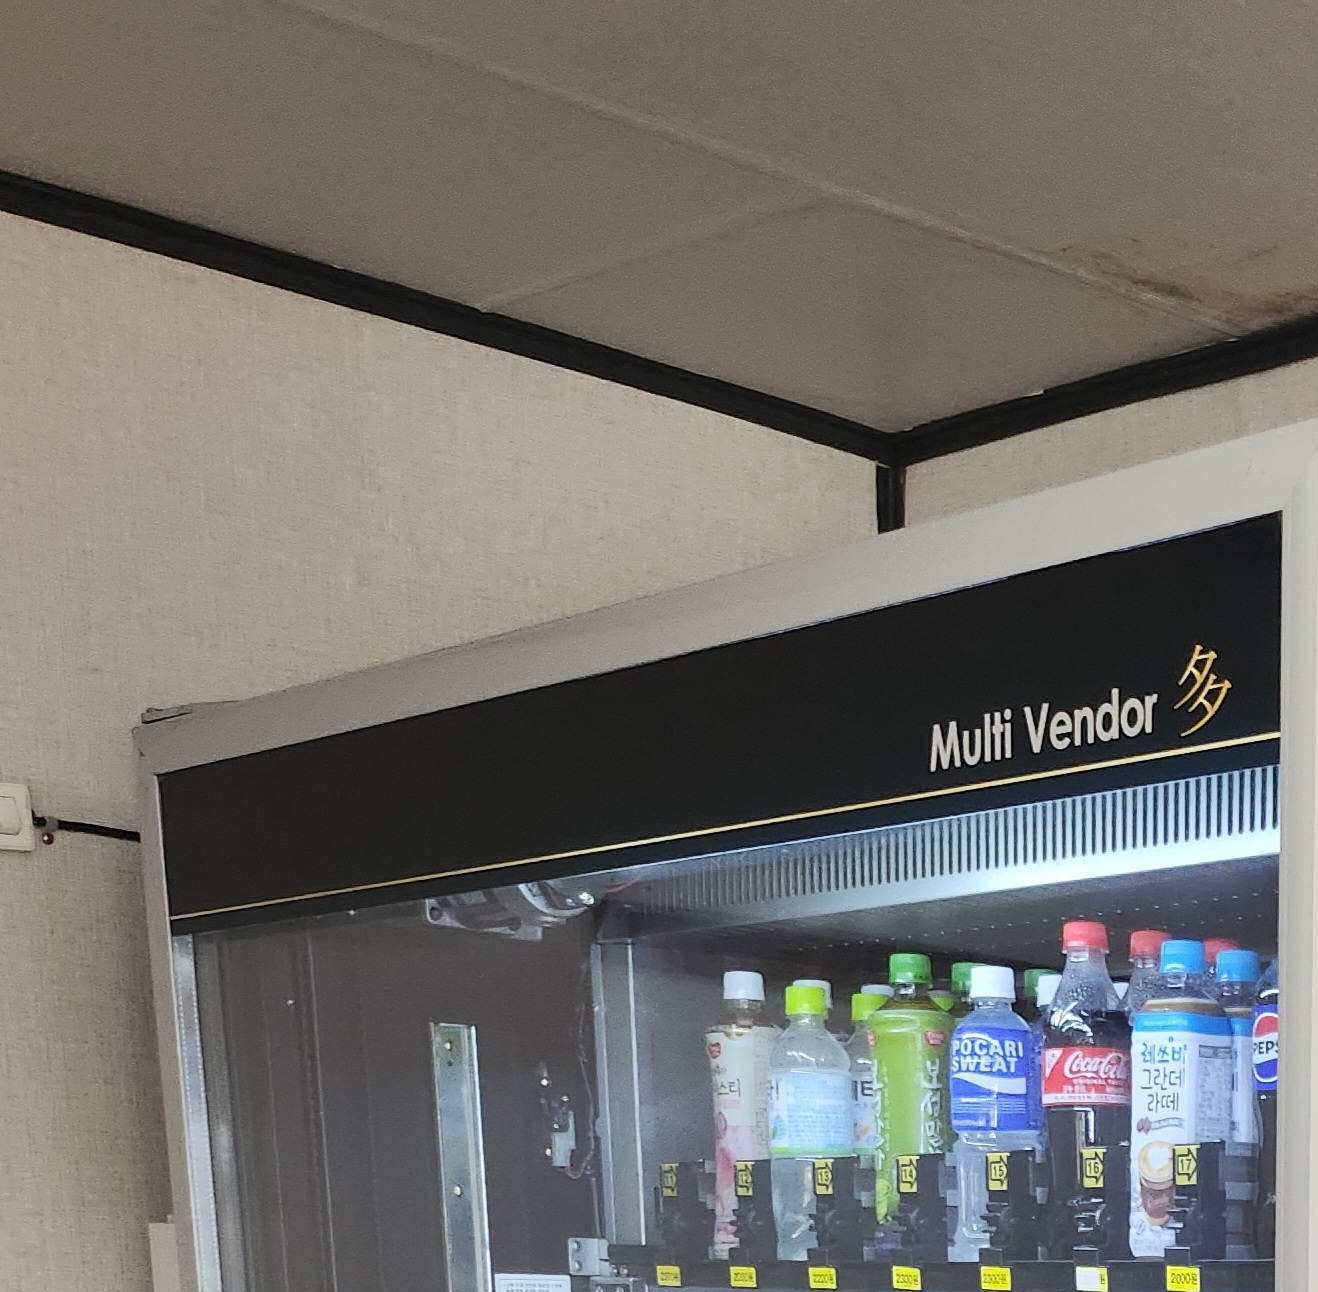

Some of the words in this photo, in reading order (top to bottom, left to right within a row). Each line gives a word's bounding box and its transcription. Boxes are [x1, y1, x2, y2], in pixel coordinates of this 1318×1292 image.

[1173, 644, 1233, 738] 多
[929, 708, 1013, 773] Multi
[1023, 687, 1159, 754] Vendor
[952, 1039, 1024, 1056] POCARI
[1141, 1043, 1187, 1064] 레쓰비
[951, 1056, 1019, 1073] SWEAT
[1140, 1067, 1186, 1091] 그란데
[1147, 1092, 1180, 1113] 라떼
[903, 1167, 915, 1180] 14
[992, 1165, 1005, 1178] 15
[1087, 1161, 1100, 1175] 16
[1180, 1158, 1192, 1172] 17
[818, 1170, 830, 1183] 13
[1170, 1272, 1198, 1286] 2000원
